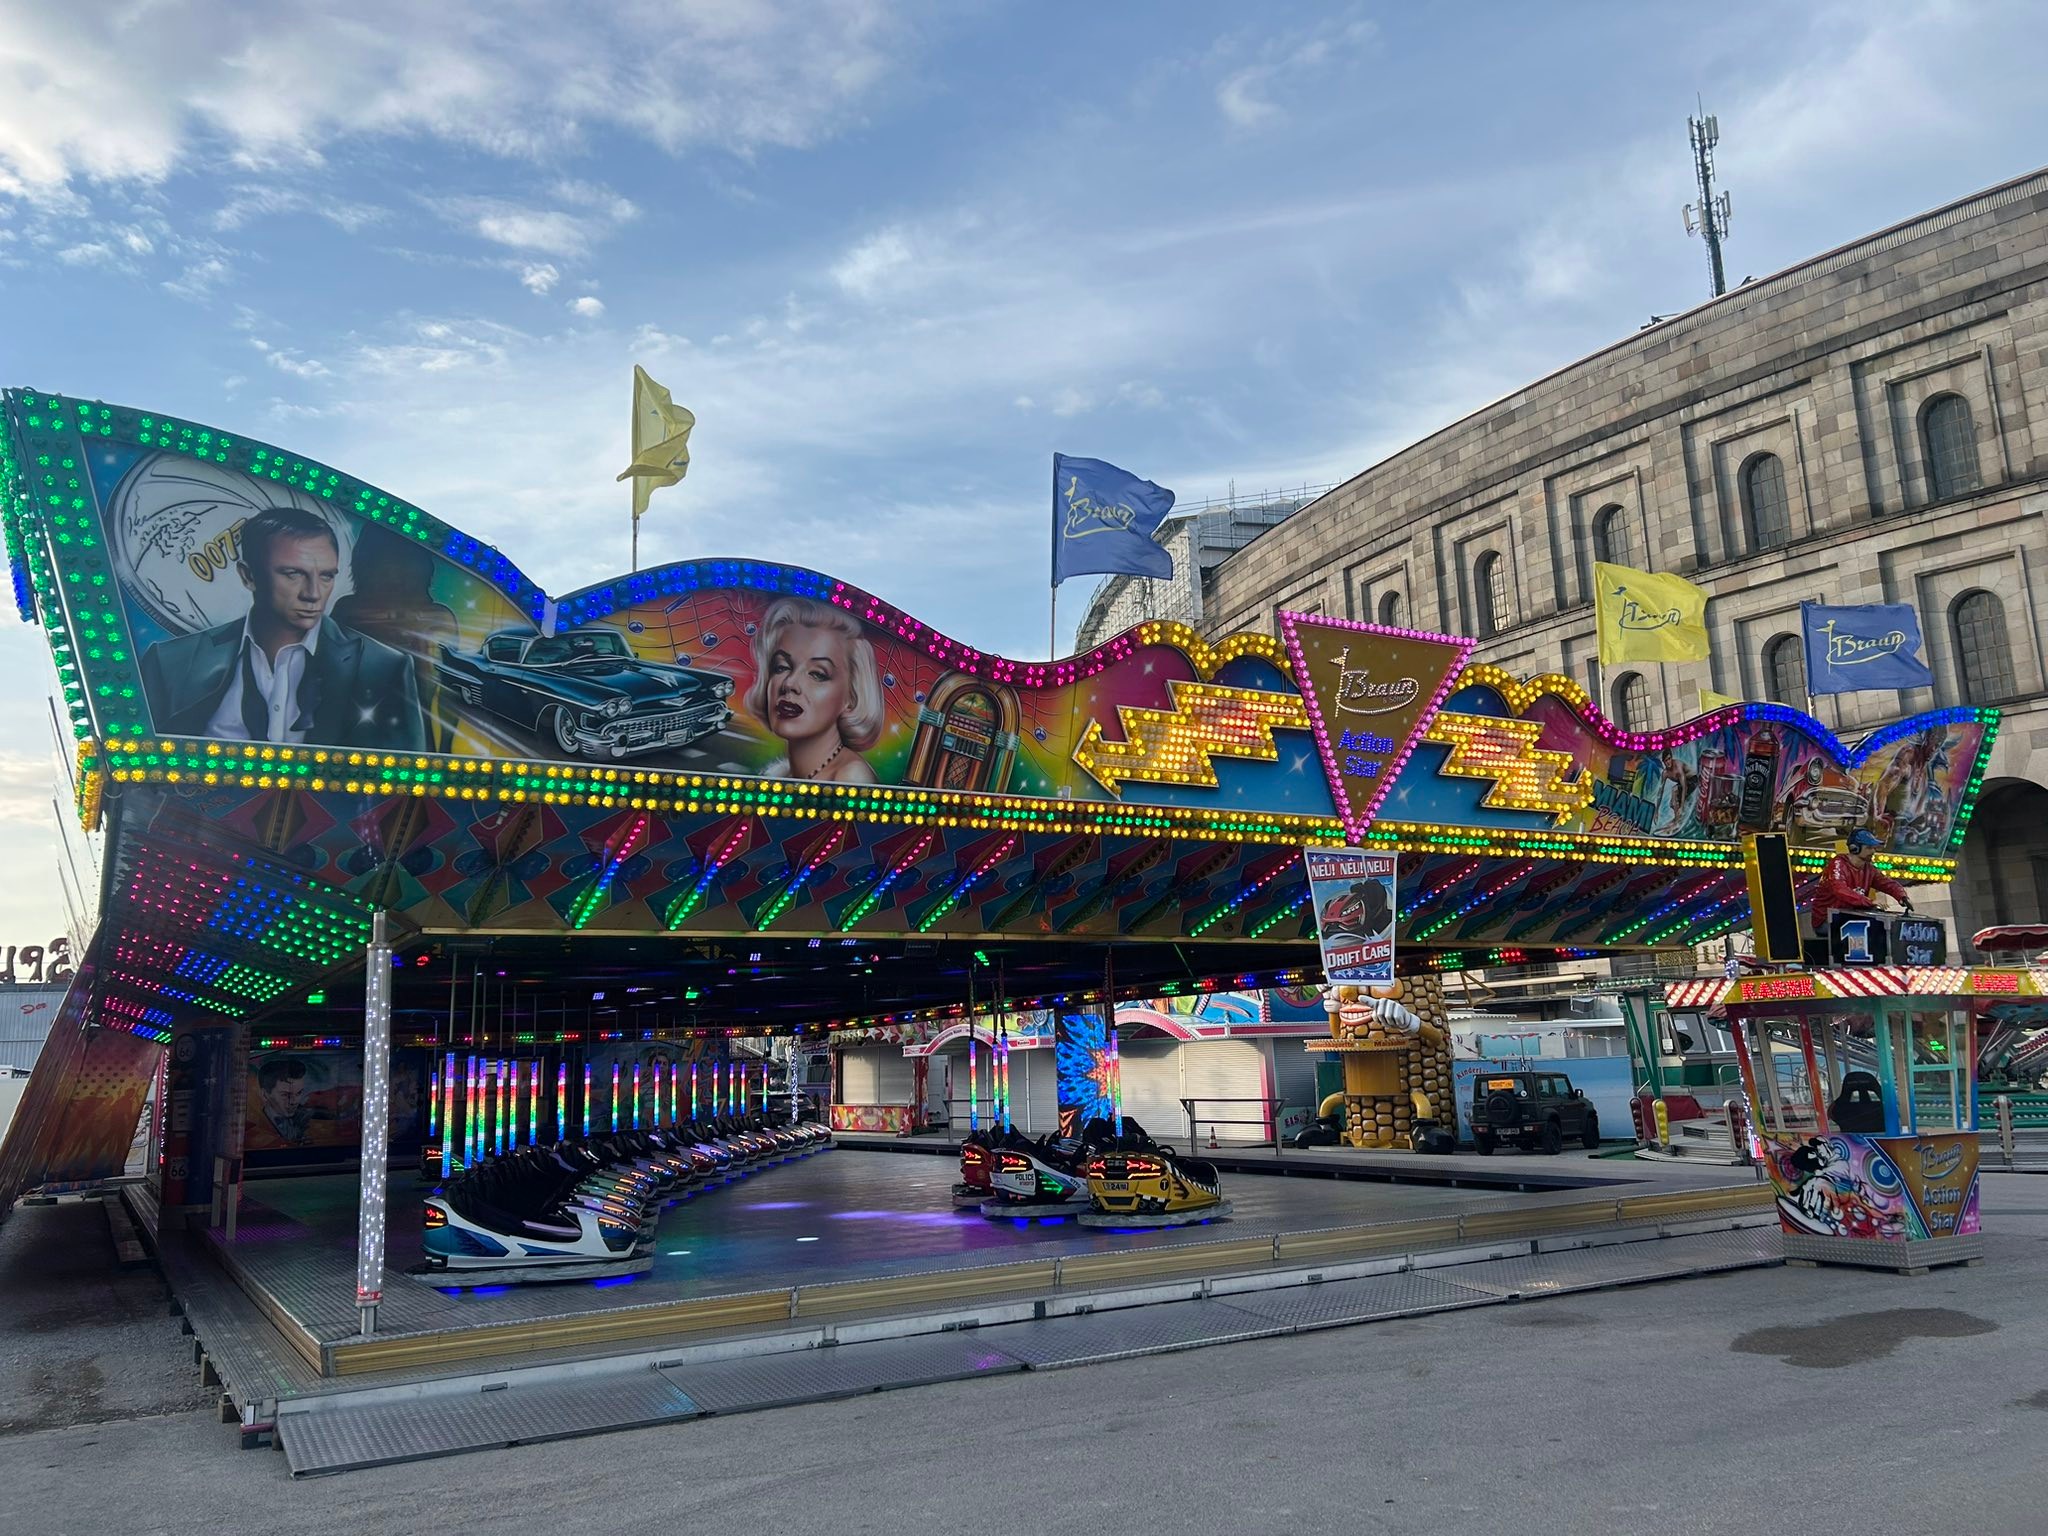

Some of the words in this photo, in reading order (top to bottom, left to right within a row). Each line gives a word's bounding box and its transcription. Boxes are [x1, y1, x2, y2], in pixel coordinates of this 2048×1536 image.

[188, 525, 241, 582] 007
[1831, 633, 1902, 658] Braun
[1341, 669, 1414, 697] Braun
[1338, 728, 1393, 754] Action
[1344, 755, 1381, 778] Star
[1592, 779, 1656, 834] MIAMI
[1311, 864, 1335, 877] NEU!
[1340, 862, 1363, 875] NEU!
[1367, 860, 1390, 873] NEU!
[1841, 920, 1873, 961] 1
[1900, 922, 1938, 941] Action
[1326, 950, 1360, 969] DRIFT
[1362, 944, 1391, 961] CARS
[1907, 945, 1933, 964] Star
[1741, 978, 1815, 1000] KASSE
[1921, 1144, 1962, 1169] Braun
[171, 1165, 186, 1178] 66
[1014, 1173, 1035, 1182] POLICE
[1923, 1185, 1961, 1206] Action
[1931, 1210, 1956, 1230] Star
